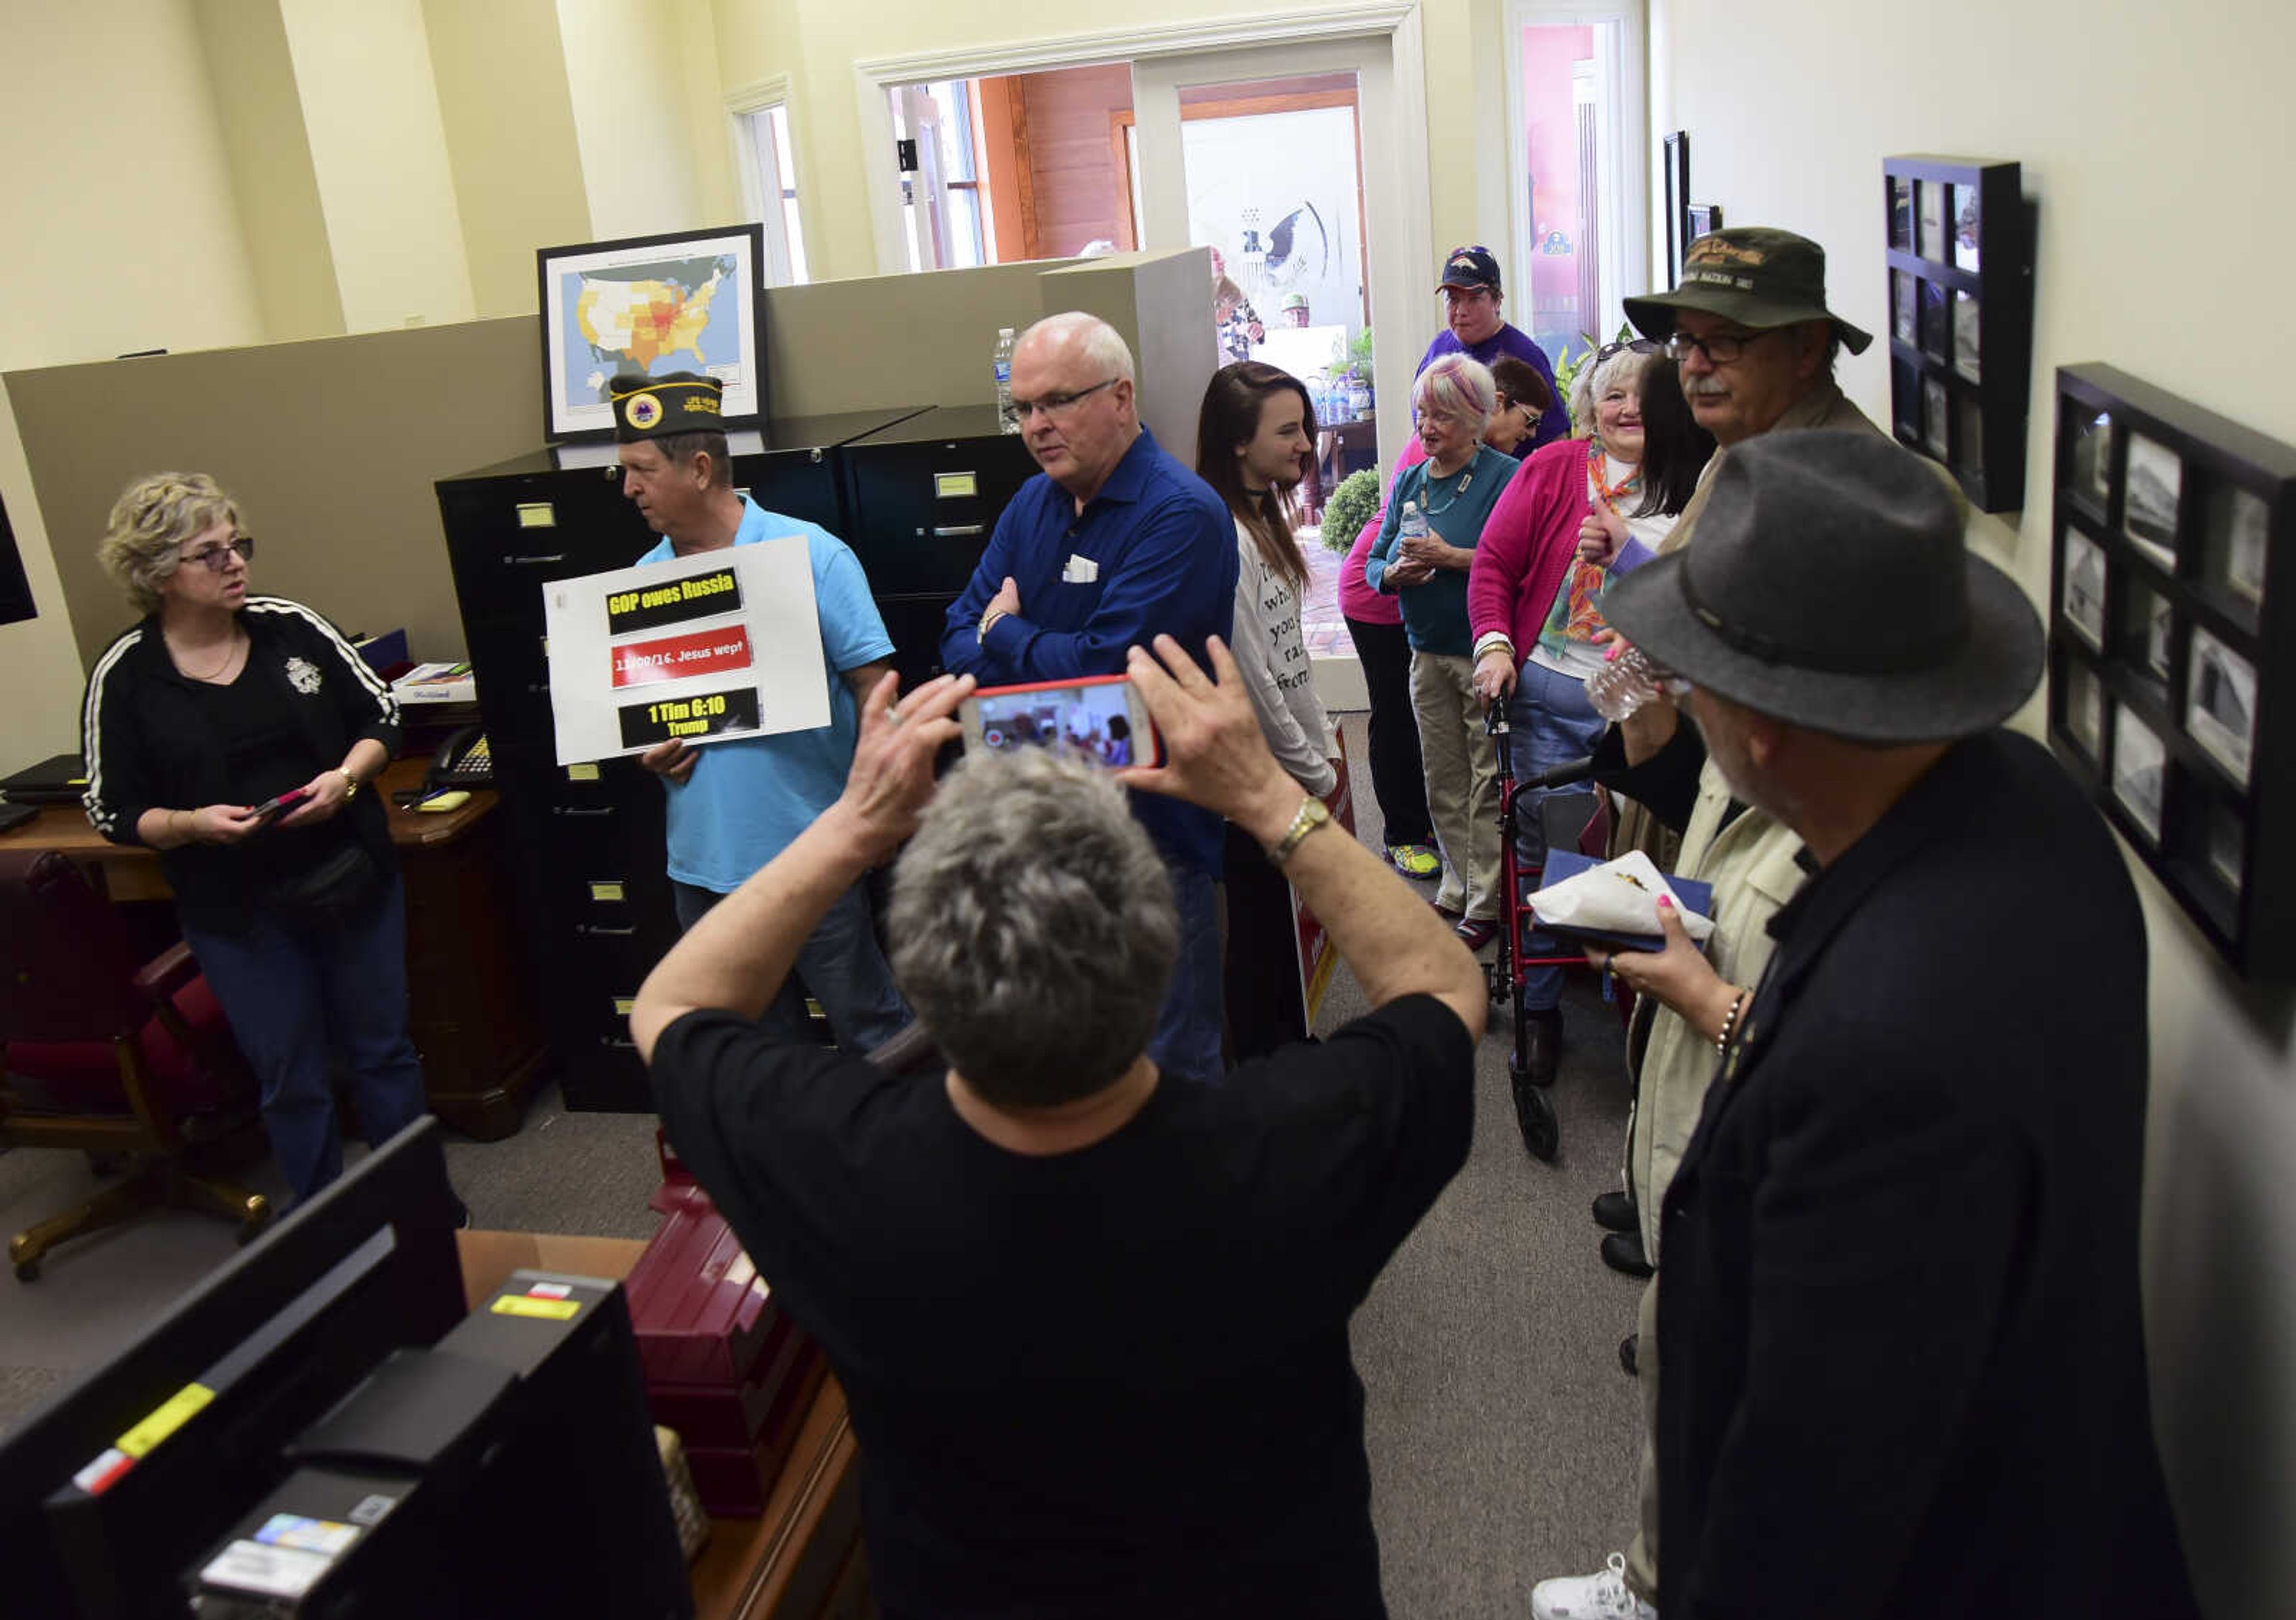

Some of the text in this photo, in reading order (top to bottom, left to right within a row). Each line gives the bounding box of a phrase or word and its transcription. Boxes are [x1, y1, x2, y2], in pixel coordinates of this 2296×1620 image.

[609, 574, 734, 615] GOP owes Russia
[678, 646, 712, 662] Jesus
[713, 640, 743, 656] wept
[648, 695, 726, 724] 1 Tim 6:10
[667, 719, 709, 737] Trump
